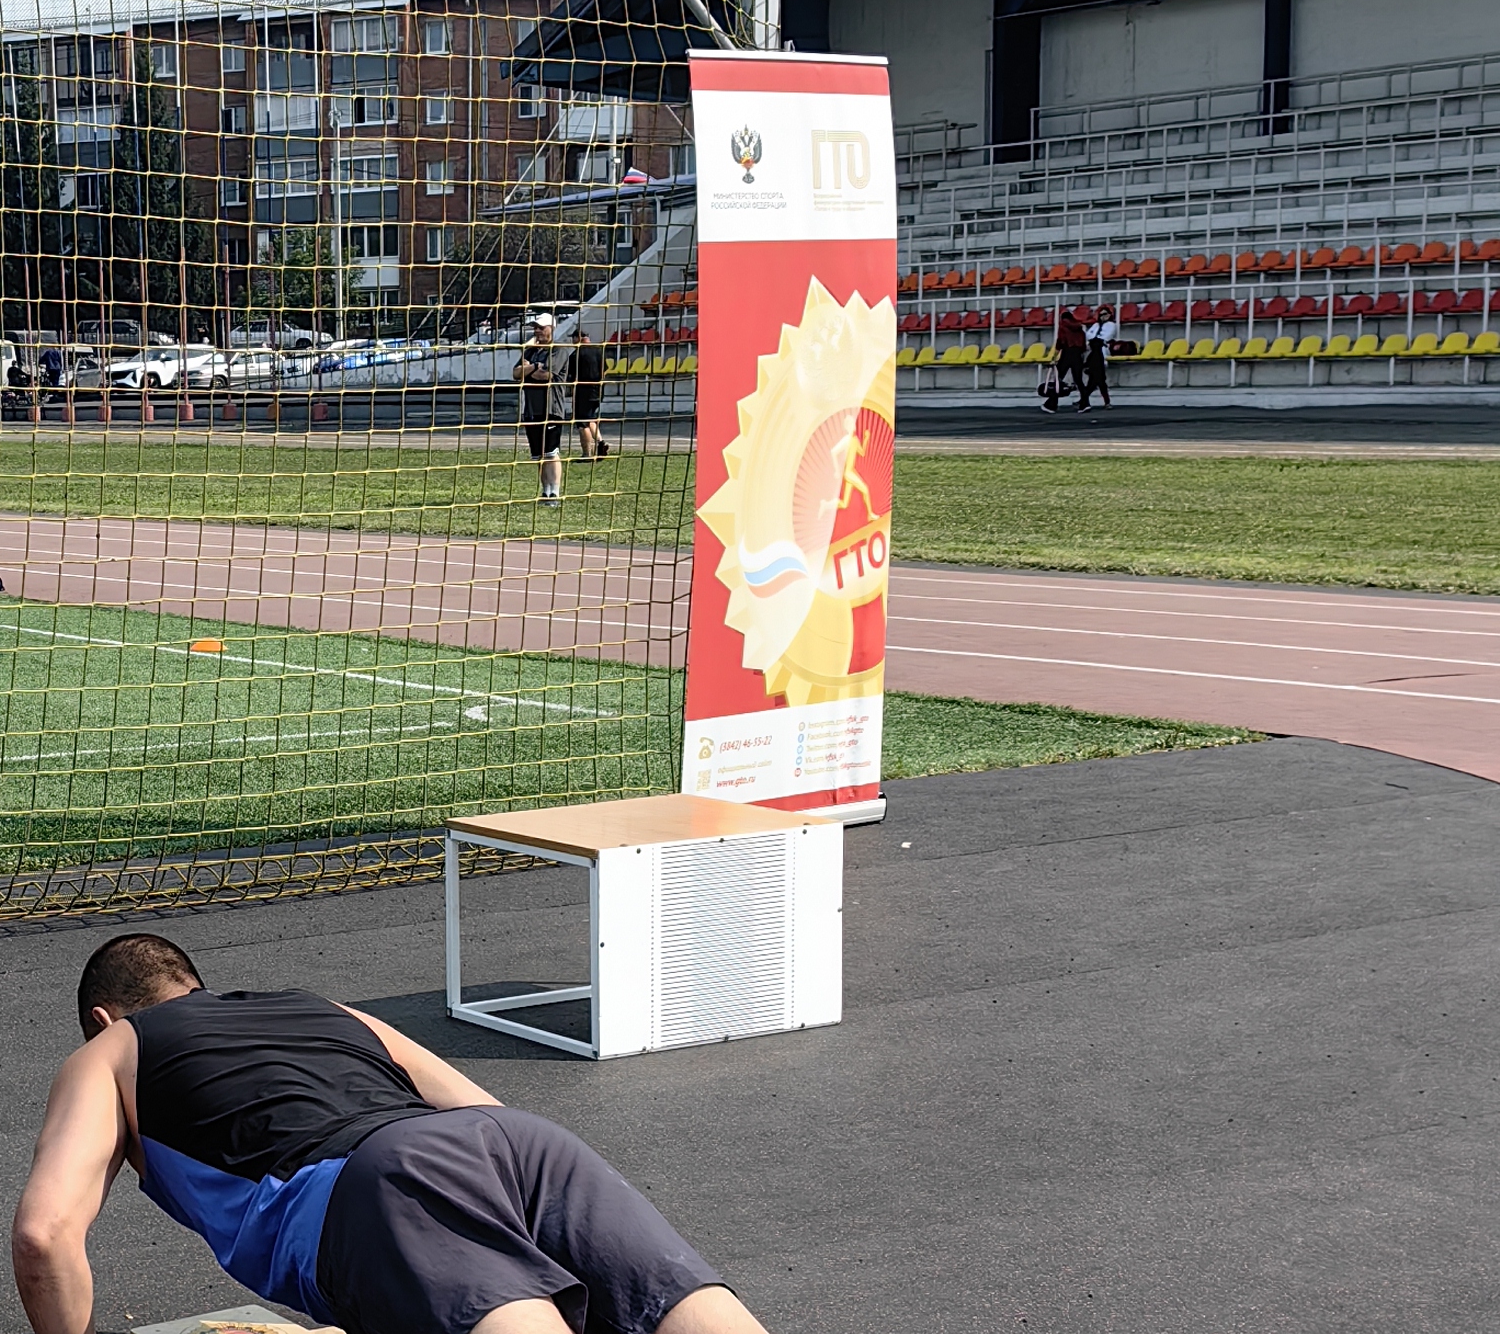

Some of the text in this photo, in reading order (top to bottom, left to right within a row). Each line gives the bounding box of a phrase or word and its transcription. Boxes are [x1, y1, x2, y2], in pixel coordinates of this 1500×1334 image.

[811, 130, 871, 189] ГТО
[713, 191, 785, 200] МИНИСТЕРСТВО СПОРТА
[710, 200, 787, 210] РОССИЙСКОЙ ФЕДЕРАЦИИ
[833, 531, 887, 590] ГТО
[719, 740, 742, 754] (3842)
